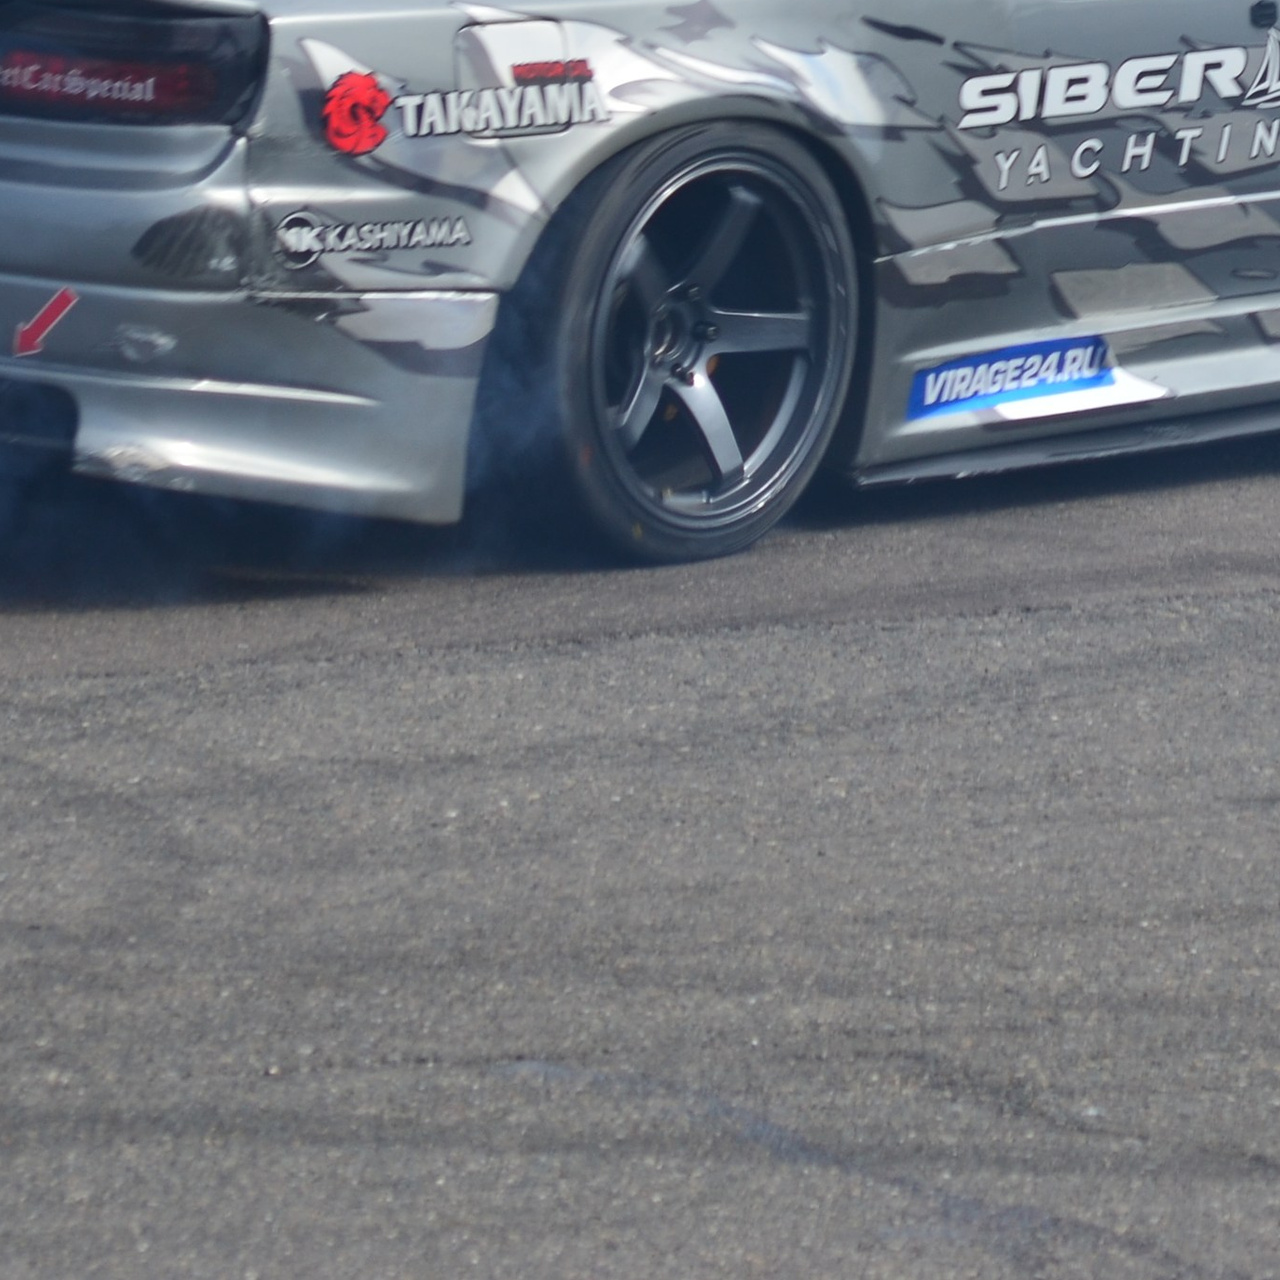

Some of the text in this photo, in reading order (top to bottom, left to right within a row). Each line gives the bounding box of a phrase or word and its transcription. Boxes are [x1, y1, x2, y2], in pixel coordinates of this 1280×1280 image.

[395, 81, 611, 138] TAKAYAMA
[323, 219, 472, 253] KASHIYAMA
[923, 345, 1105, 407] VIRAGE24.RU
